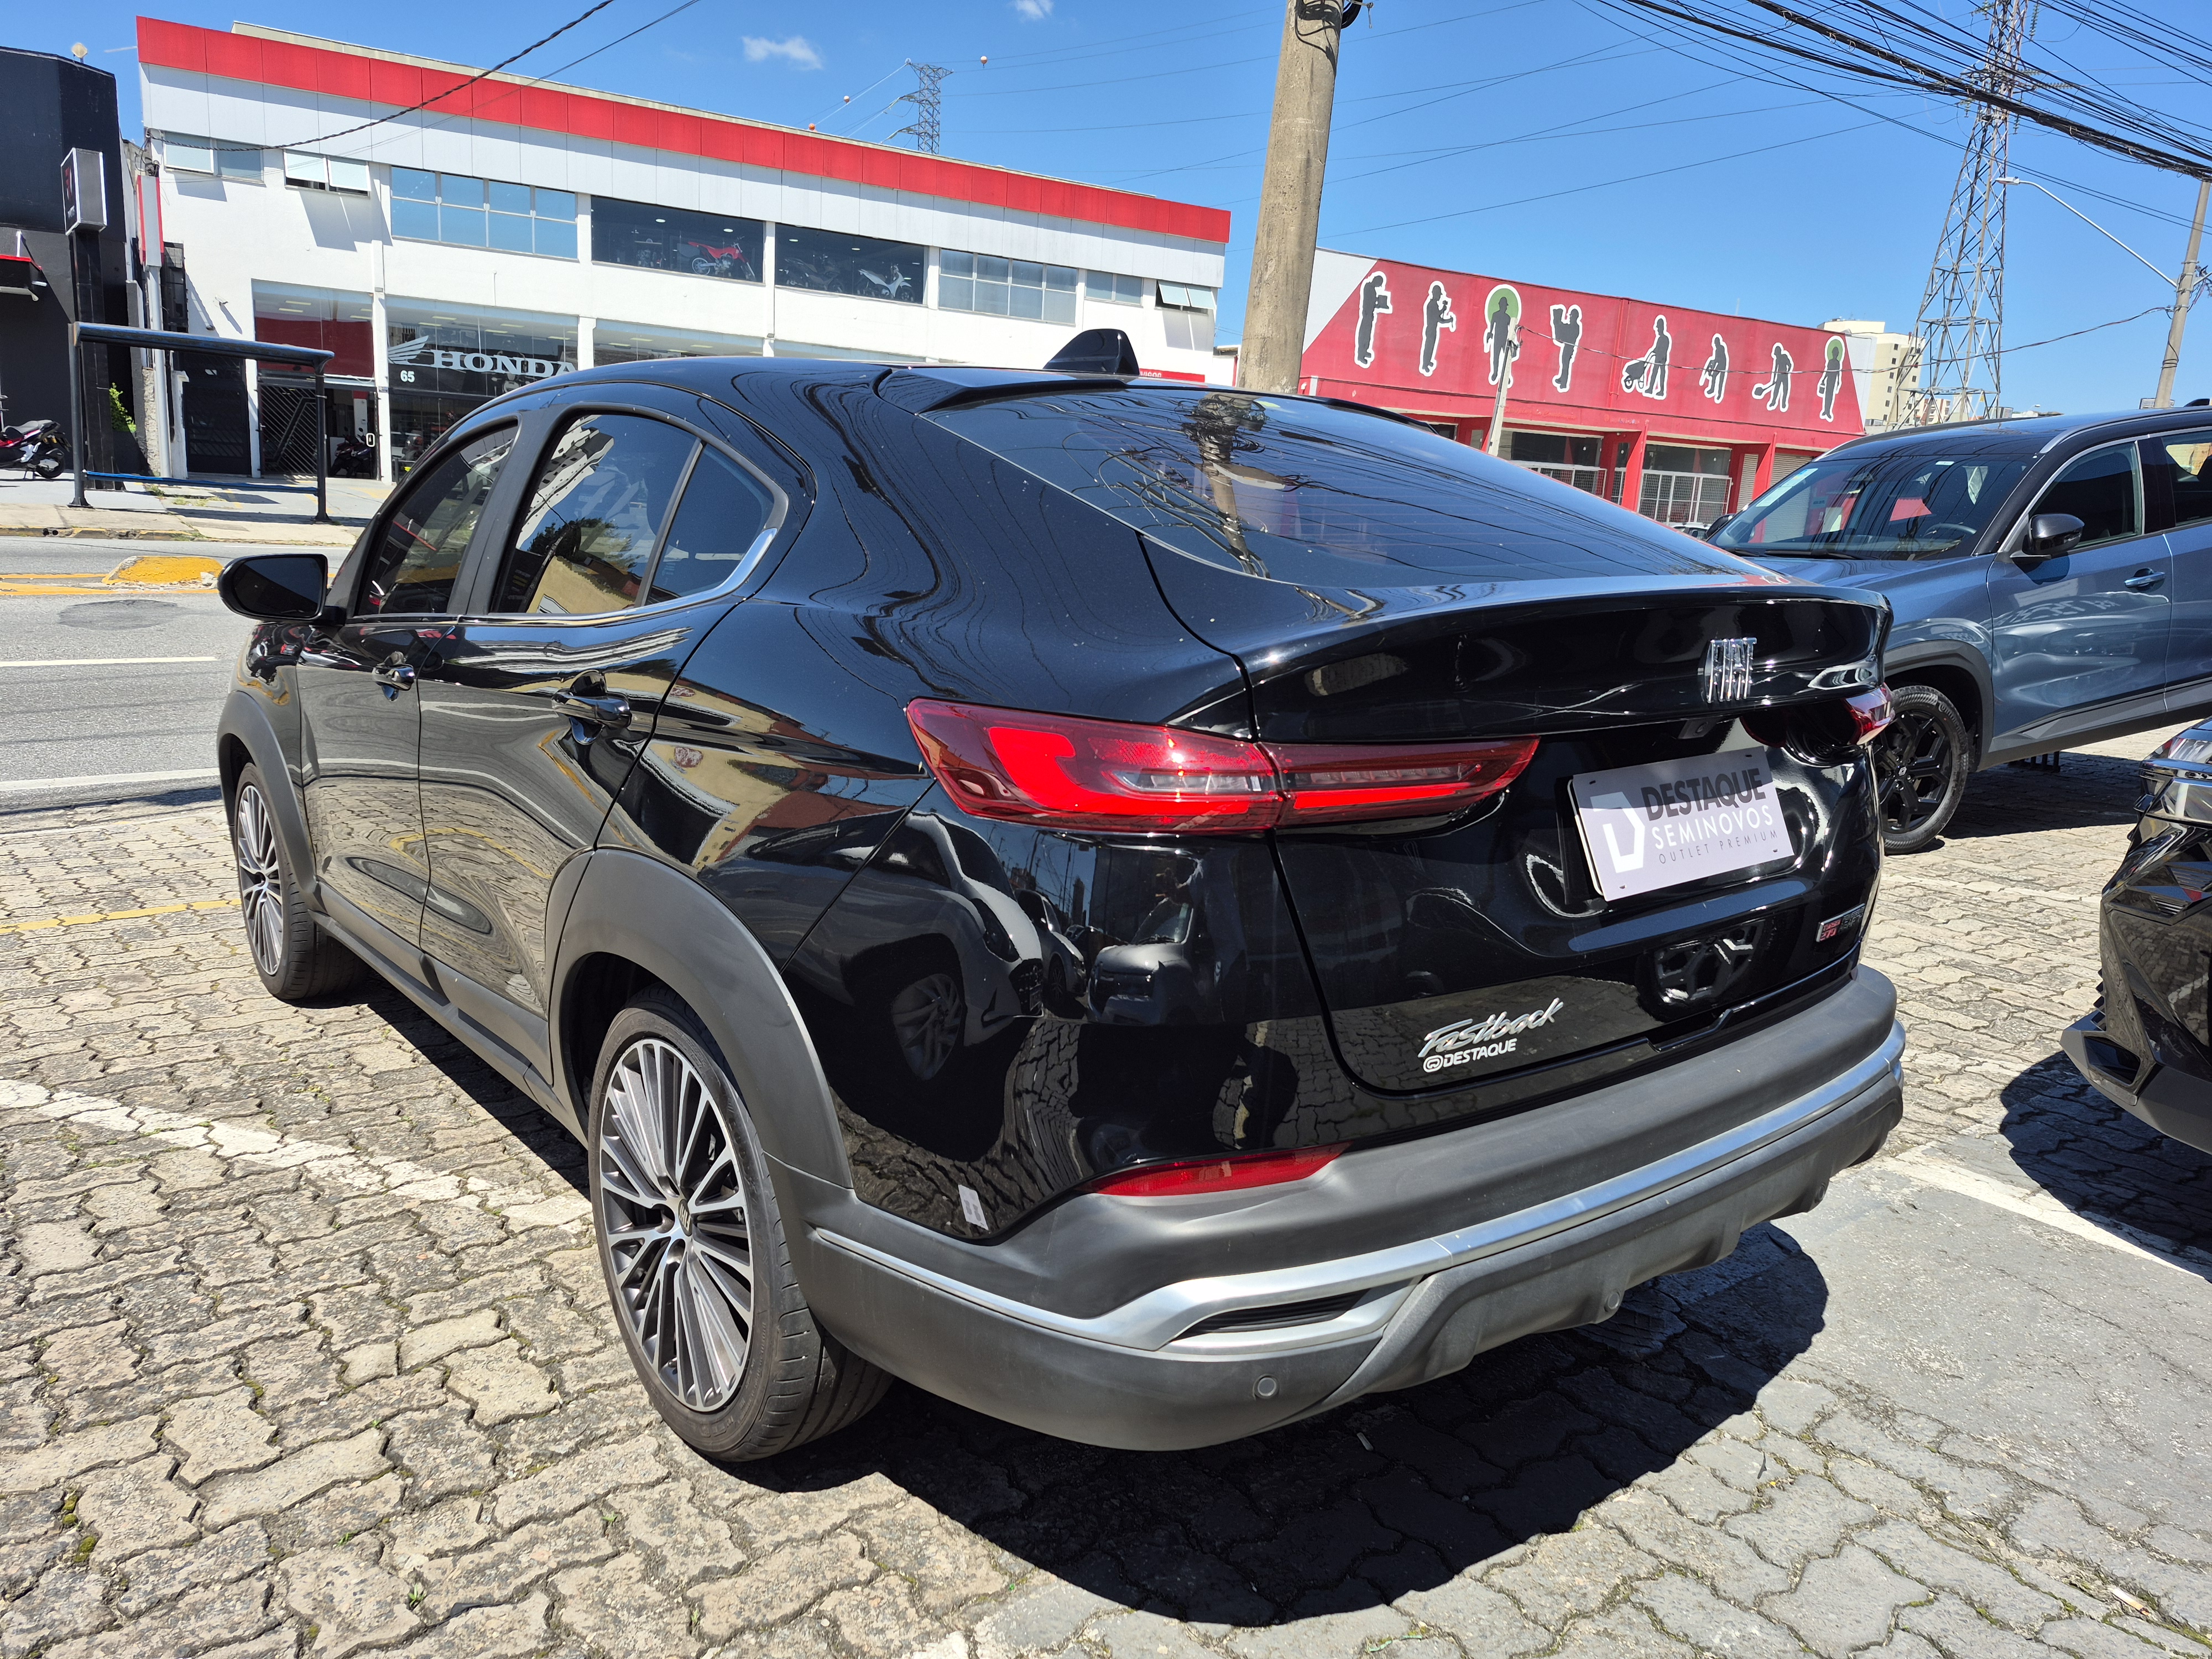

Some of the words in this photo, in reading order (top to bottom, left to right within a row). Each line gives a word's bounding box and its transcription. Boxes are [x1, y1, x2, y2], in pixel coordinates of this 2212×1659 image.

[400, 370, 415, 383] 65
[431, 349, 577, 377] HONDA
[1705, 638, 1757, 703] FIAT
[1642, 768, 1766, 821] DESTAQUE
[1652, 805, 1773, 850] SEMINOVOS
[1659, 844, 1710, 864] OUTLET
[1720, 830, 1778, 851] PREMIUM
[1417, 997, 1564, 1058] Fastback
[1423, 1038, 1517, 1073] @DESTAQUE
